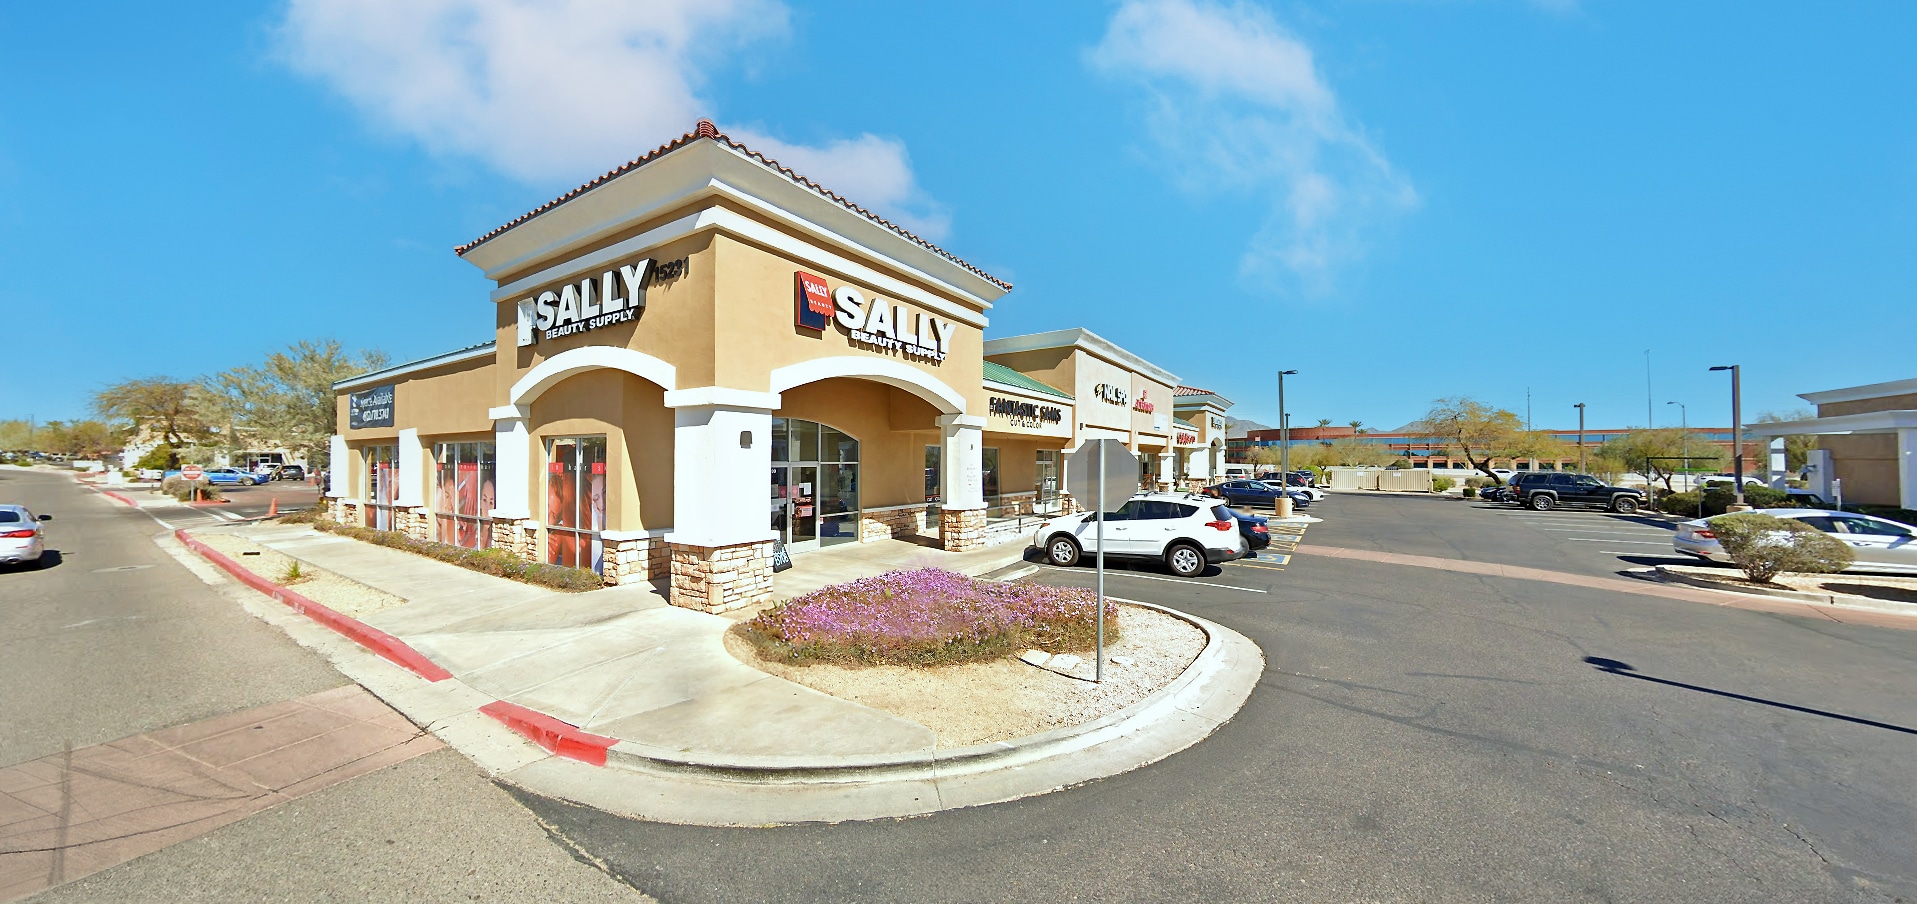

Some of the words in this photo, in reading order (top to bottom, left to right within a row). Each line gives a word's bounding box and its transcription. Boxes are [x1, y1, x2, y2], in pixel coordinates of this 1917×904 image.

[654, 256, 690, 283] 15231
[536, 258, 651, 331] SALLY
[804, 280, 828, 298] SALLY
[545, 321, 585, 340] BEAUTY
[589, 308, 635, 329] SUPPLY
[834, 286, 956, 354] SALLY
[851, 329, 902, 350] BEAUTY
[905, 344, 946, 361] SUPPLY
[989, 397, 1039, 418] FANTASTIC
[1040, 405, 1062, 422] SAMS
[1010, 419, 1021, 427] CUT
[1026, 422, 1042, 430] COLOR
